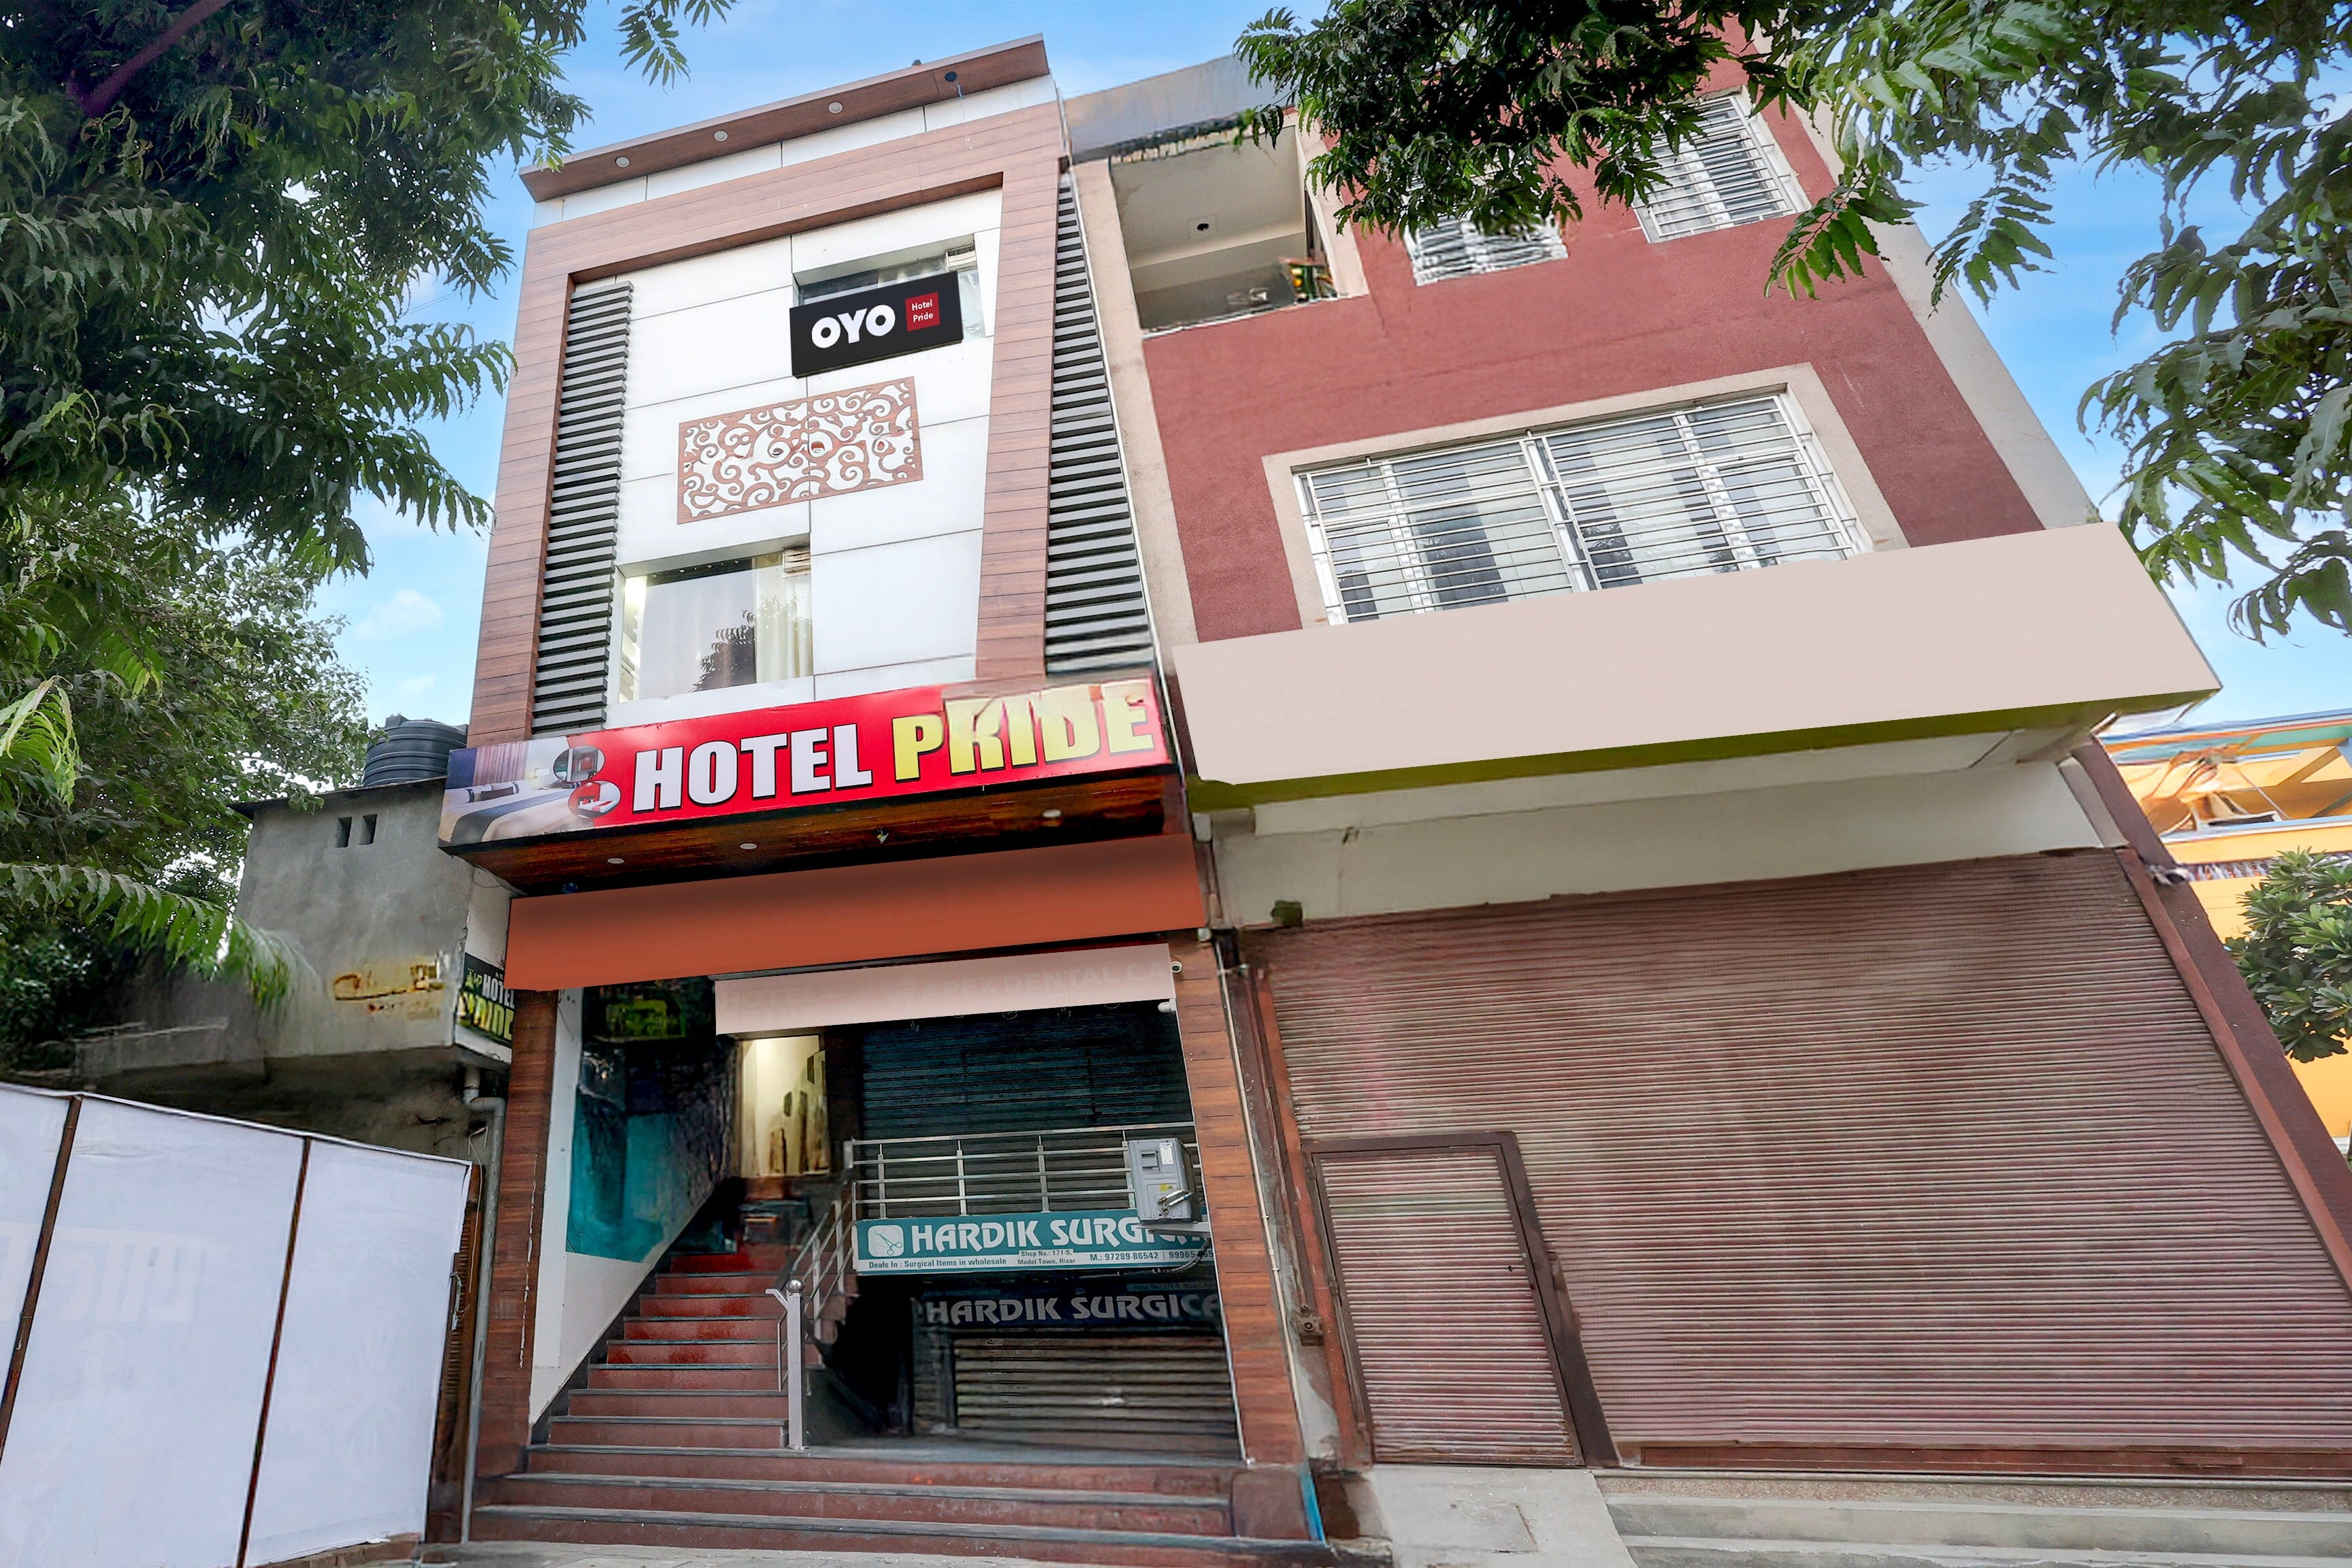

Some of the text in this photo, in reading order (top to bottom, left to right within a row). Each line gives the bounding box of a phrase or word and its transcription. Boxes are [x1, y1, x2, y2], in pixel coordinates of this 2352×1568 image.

[911, 299, 932, 311] Hotel
[913, 312, 934, 323] Pride
[811, 304, 896, 348] OYO
[632, 723, 874, 812] HOTEL
[911, 1220, 1042, 1254] HARDIK
[904, 1260, 934, 1268] Surgical
[925, 1298, 1062, 1324] HARDIK
